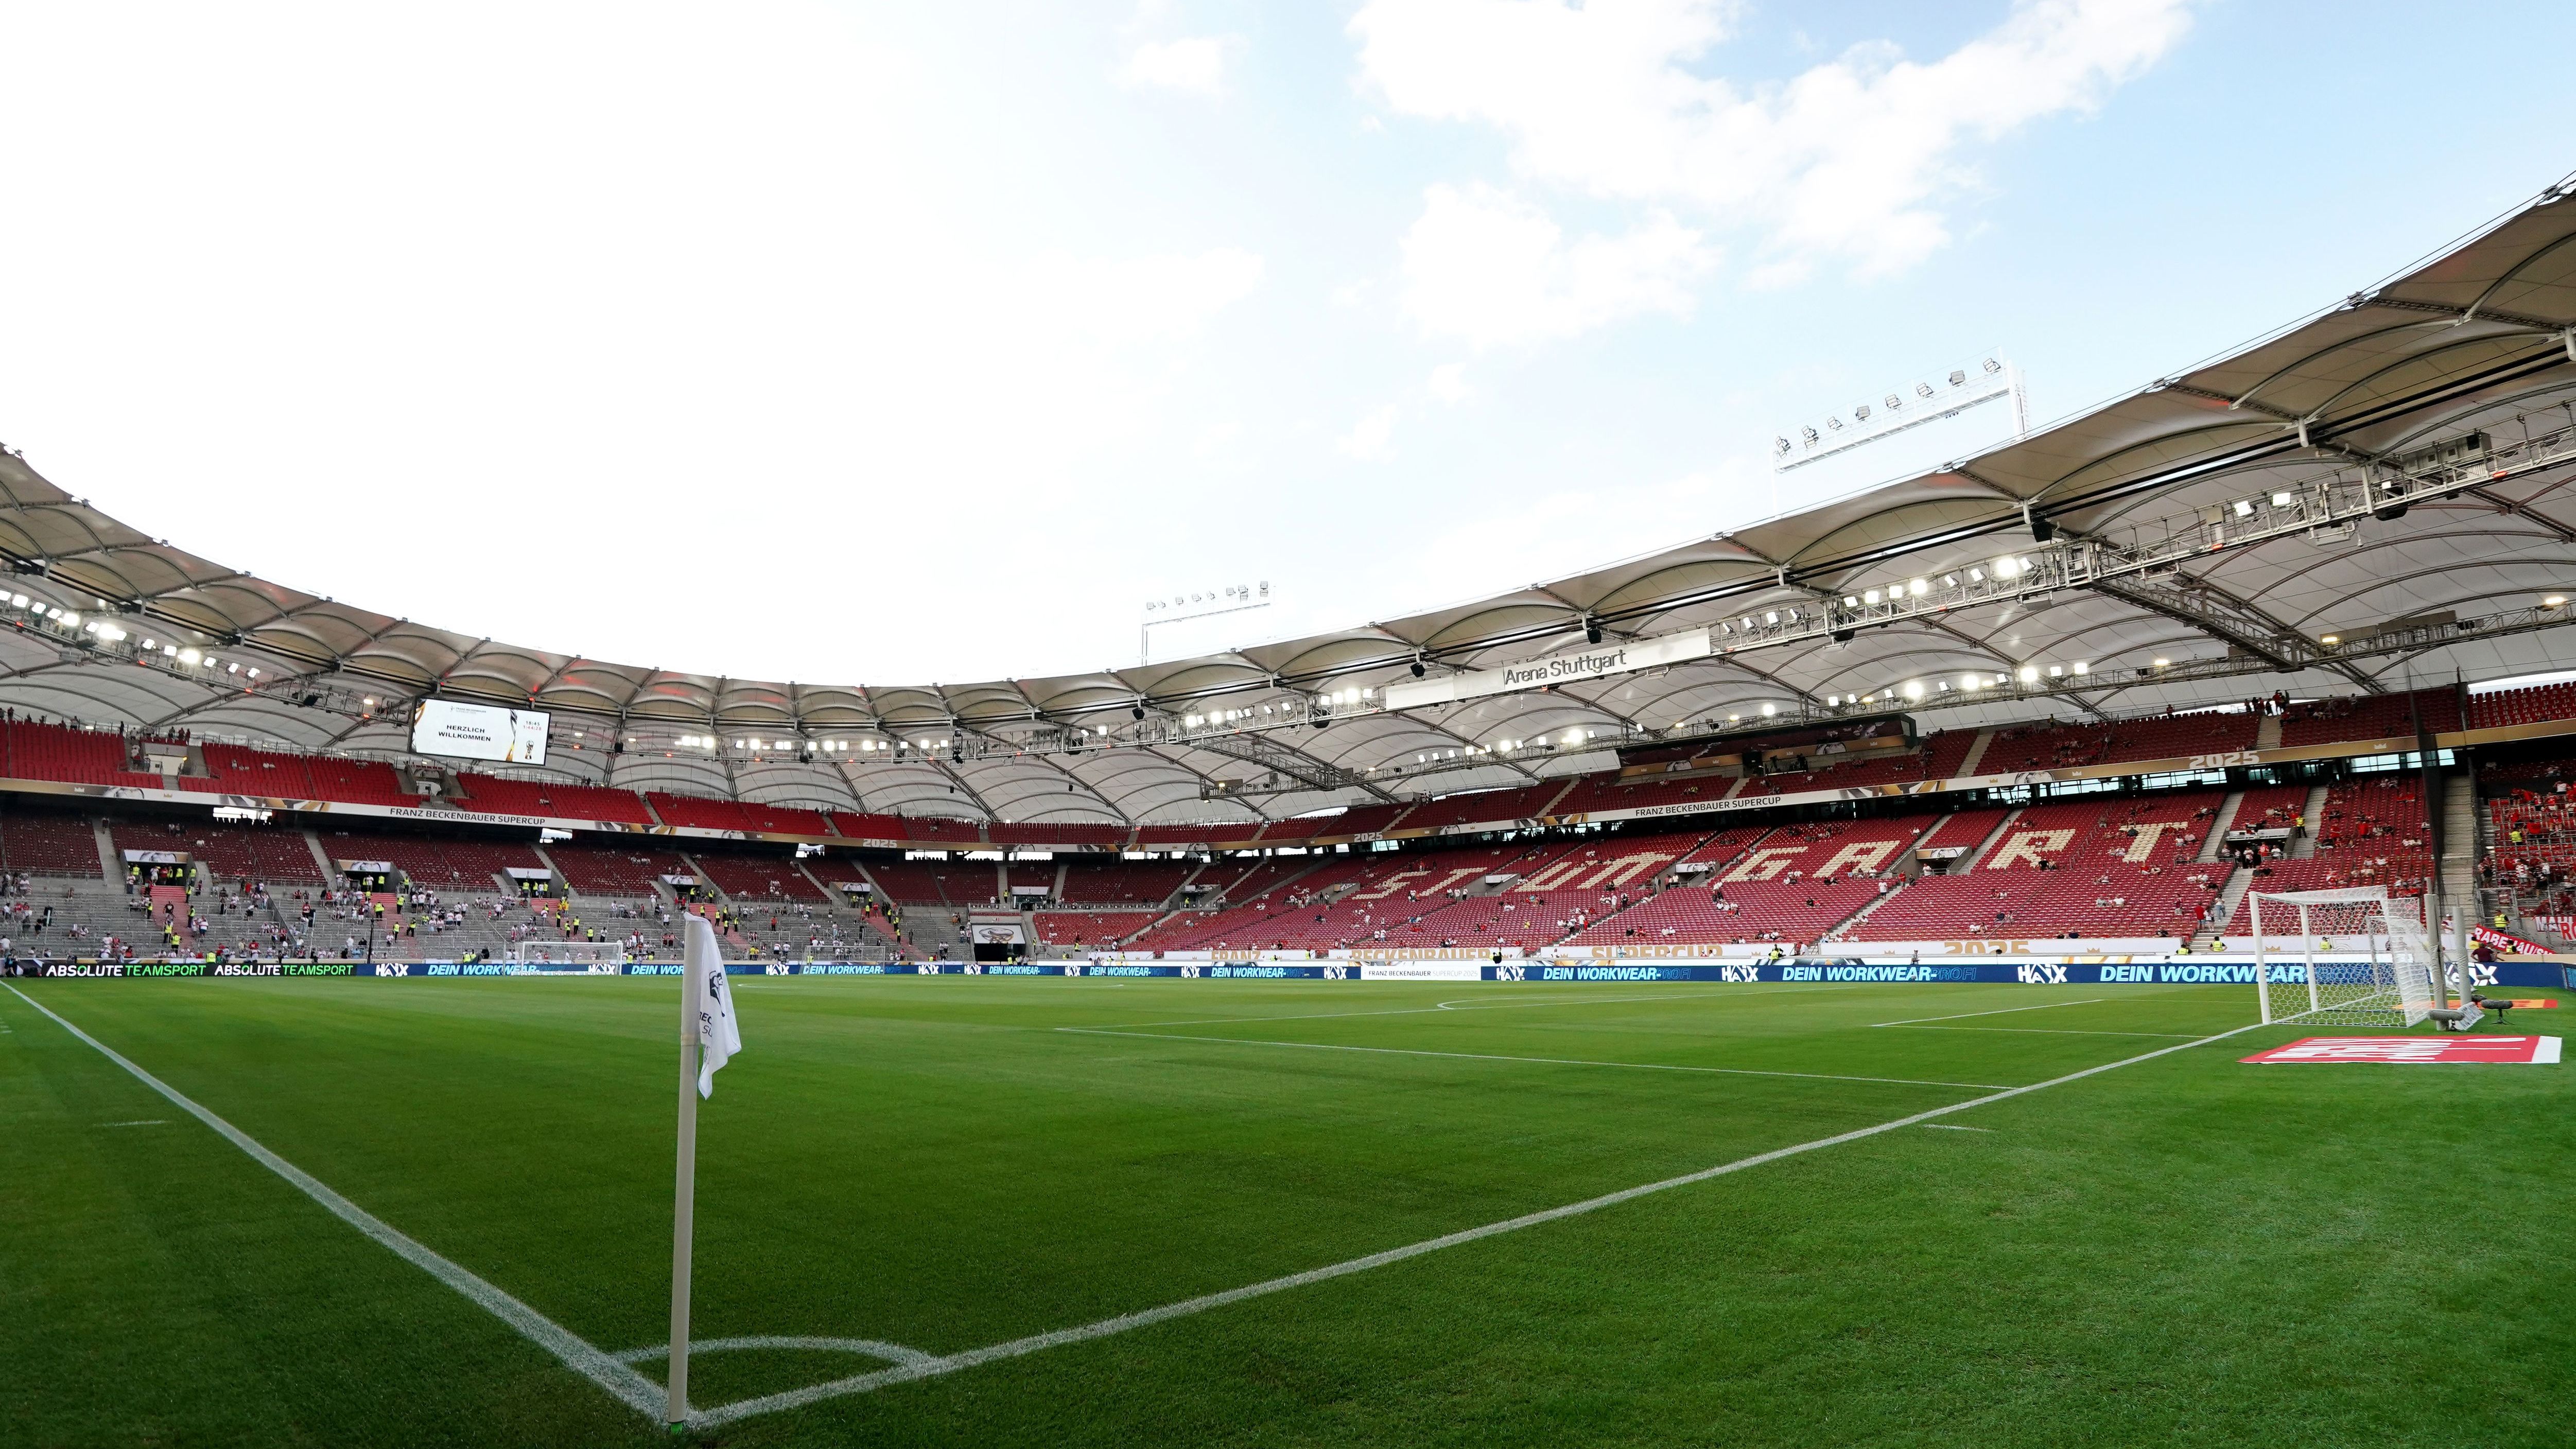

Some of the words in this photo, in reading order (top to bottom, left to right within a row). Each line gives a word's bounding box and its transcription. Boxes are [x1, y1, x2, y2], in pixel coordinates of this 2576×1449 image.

[1505, 667, 1547, 685] Arena
[1550, 649, 1626, 674] Stuttgart
[446, 725, 485, 734] HERZLICH
[438, 731, 491, 742] WILLKOMMEN
[2189, 750, 2260, 769] 2025
[1635, 807, 1663, 817] FRANZ
[1665, 801, 1730, 814] BECKENBAUER
[1732, 796, 1781, 808] SUPERCUP
[390, 808, 423, 817] FRANZ
[426, 811, 496, 823] BECKENBAUER
[498, 815, 545, 825] SUPERCUP
[1354, 831, 1383, 842] 2025
[862, 838, 897, 848] 2025
[46, 965, 123, 977] ABSOLUTE
[125, 965, 206, 976] TEAMSPORT
[214, 965, 281, 976] ABSOLUTE
[283, 965, 354, 975] TEAMSPORT
[427, 965, 460, 975] DEIN
[631, 965, 656, 975] DEIN
[803, 965, 826, 974] DEIN
[989, 966, 1003, 974] DEIN
[1089, 967, 1106, 976] DEIN
[1211, 967, 1232, 977] DEIN
[1543, 967, 1574, 980] DEIN
[1782, 966, 1822, 981] DEIN
[2100, 966, 2153, 982] DEIN
